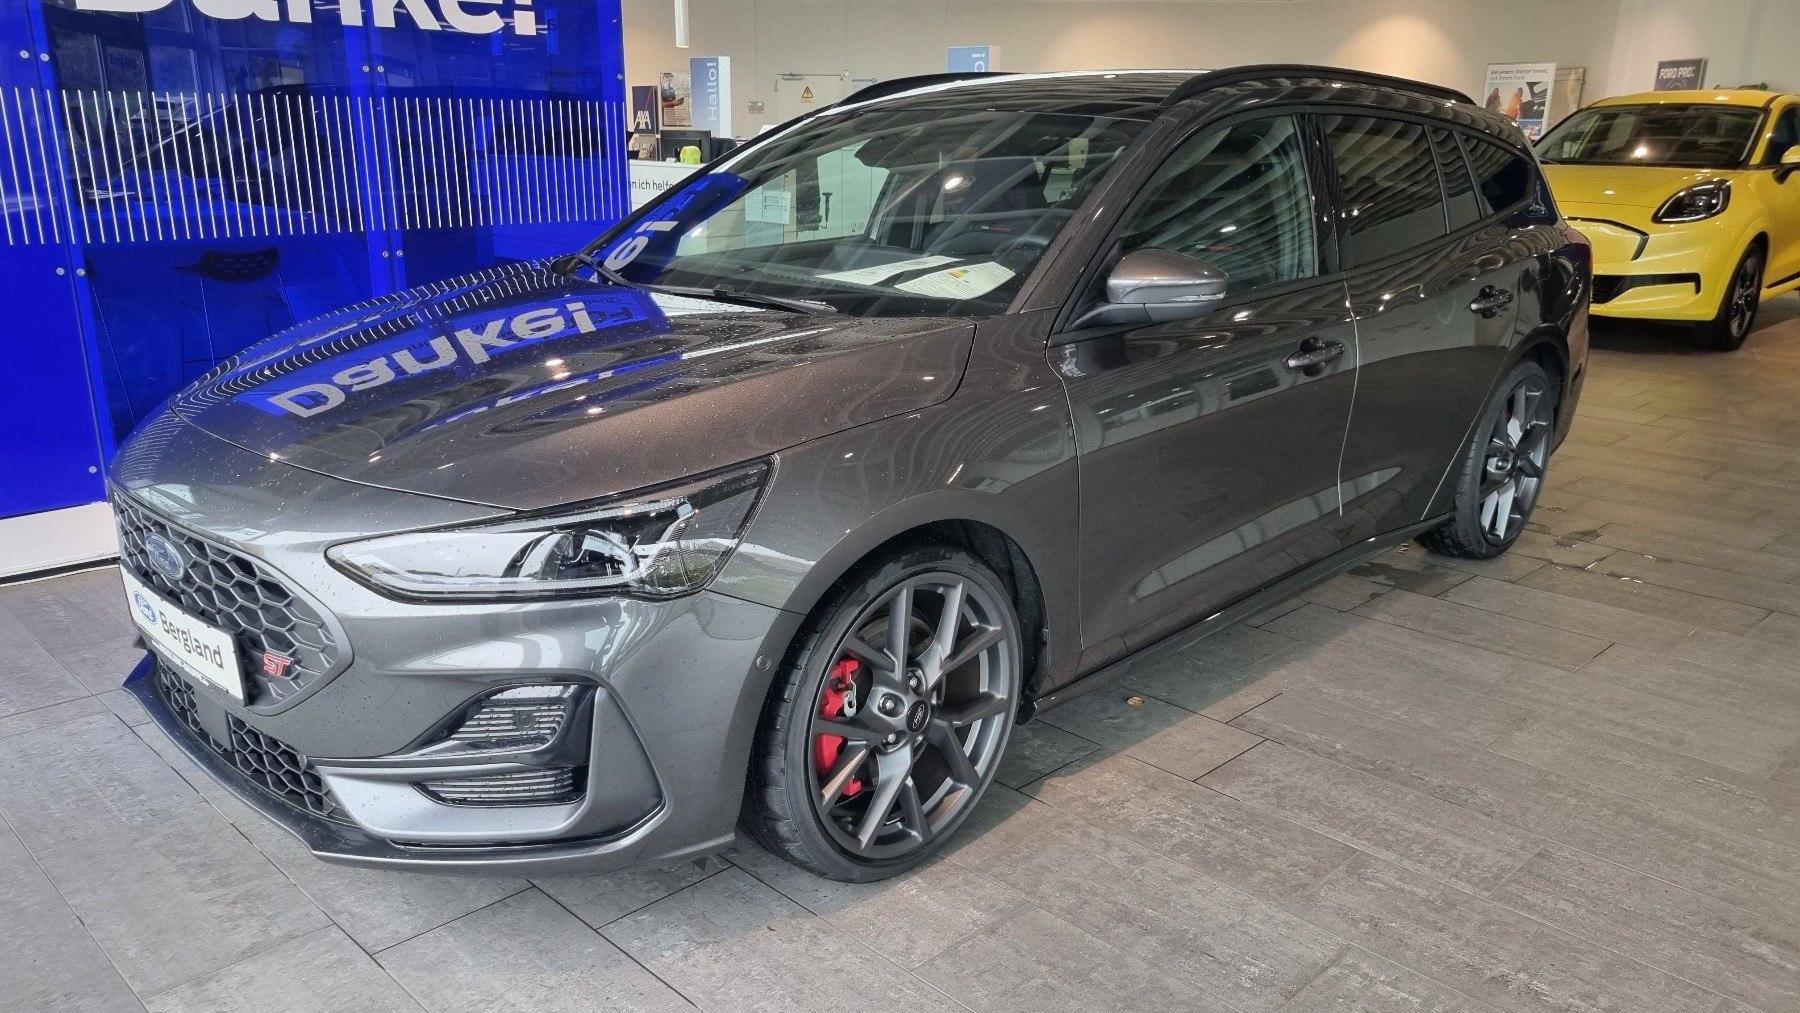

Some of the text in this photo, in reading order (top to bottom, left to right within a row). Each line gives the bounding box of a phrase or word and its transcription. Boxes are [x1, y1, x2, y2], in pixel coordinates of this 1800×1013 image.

[1659, 67, 1678, 79] FORD
[706, 62, 718, 121] Hallo!
[634, 110, 652, 130] AXA
[638, 179, 651, 190] ich
[159, 611, 224, 669] Bergland
[263, 651, 294, 678] ST
